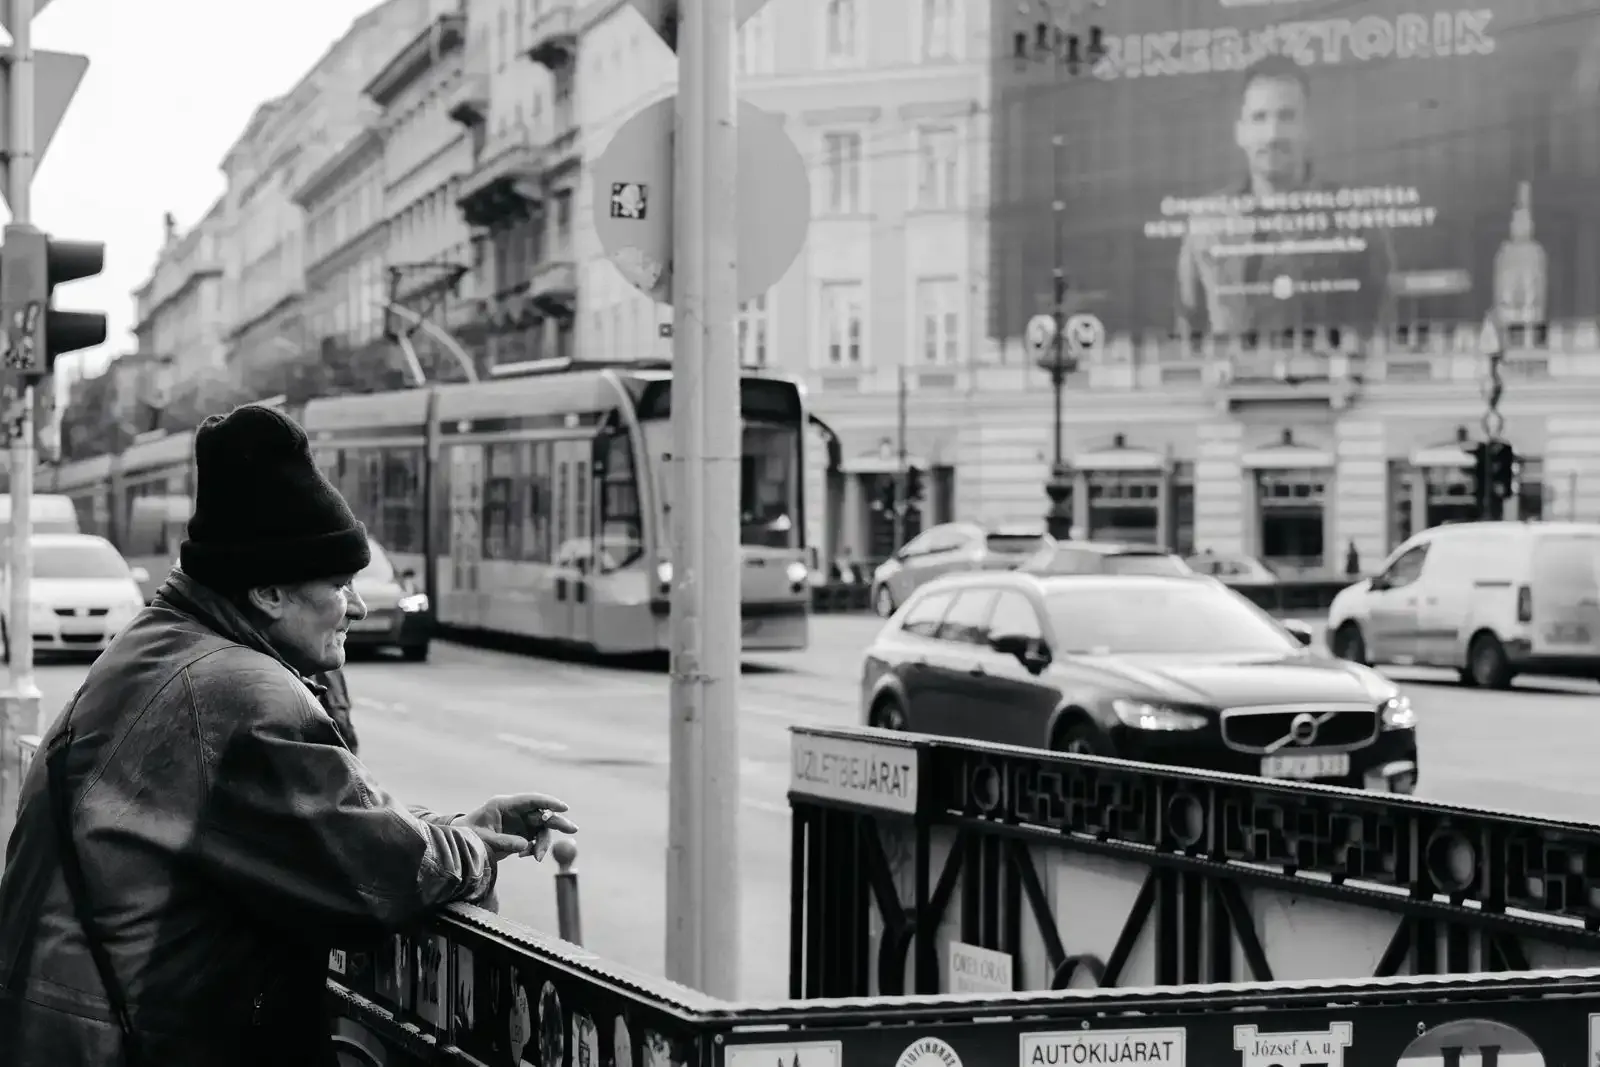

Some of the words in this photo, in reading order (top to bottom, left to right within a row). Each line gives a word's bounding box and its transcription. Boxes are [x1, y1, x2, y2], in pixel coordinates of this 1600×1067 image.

[1032, 1036, 1173, 1064] AUTÓKIJÁRAT
[1252, 1039, 1298, 1057] József
[1300, 1040, 1318, 1055] A.
[1323, 1042, 1336, 1055] u.
